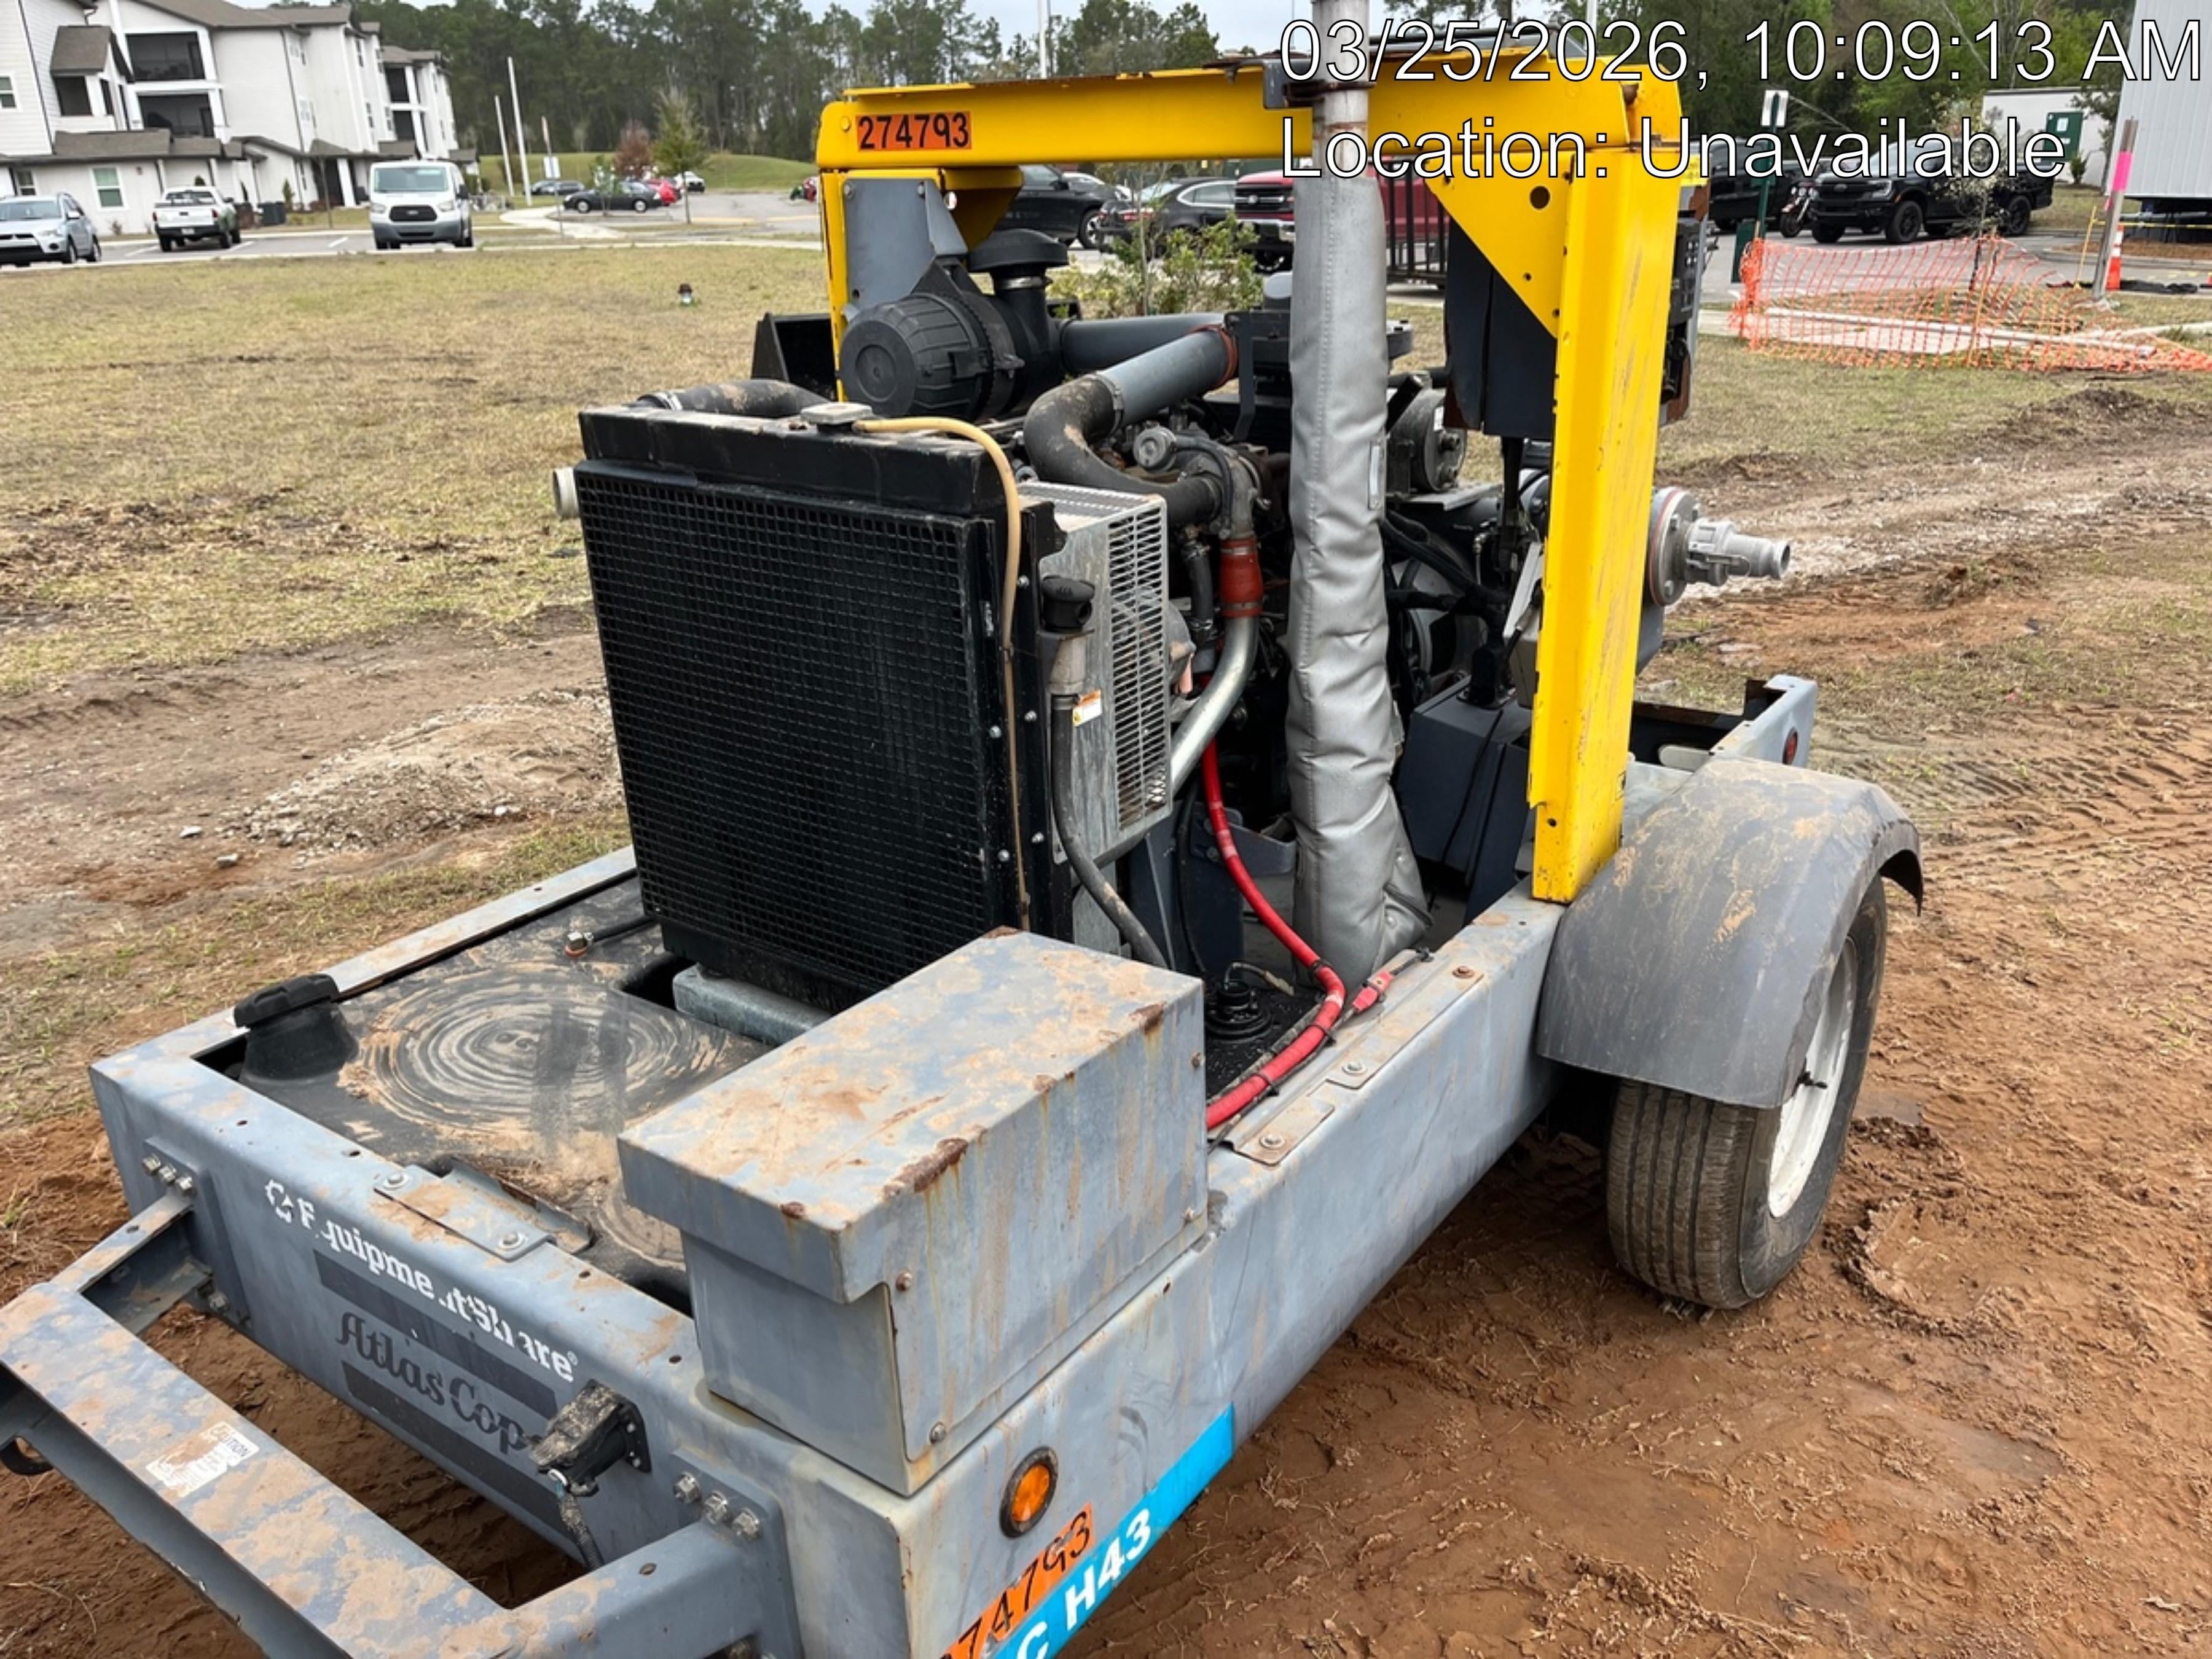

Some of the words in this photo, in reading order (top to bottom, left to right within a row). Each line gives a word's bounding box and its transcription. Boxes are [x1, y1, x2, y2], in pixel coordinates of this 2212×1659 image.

[858, 112, 969, 149] 274793
[337, 1312, 445, 1406] Atlas
[449, 1378, 544, 1454] Cop
[940, 1510, 1090, 1659] 74793
[1065, 1508, 1151, 1631] H43
